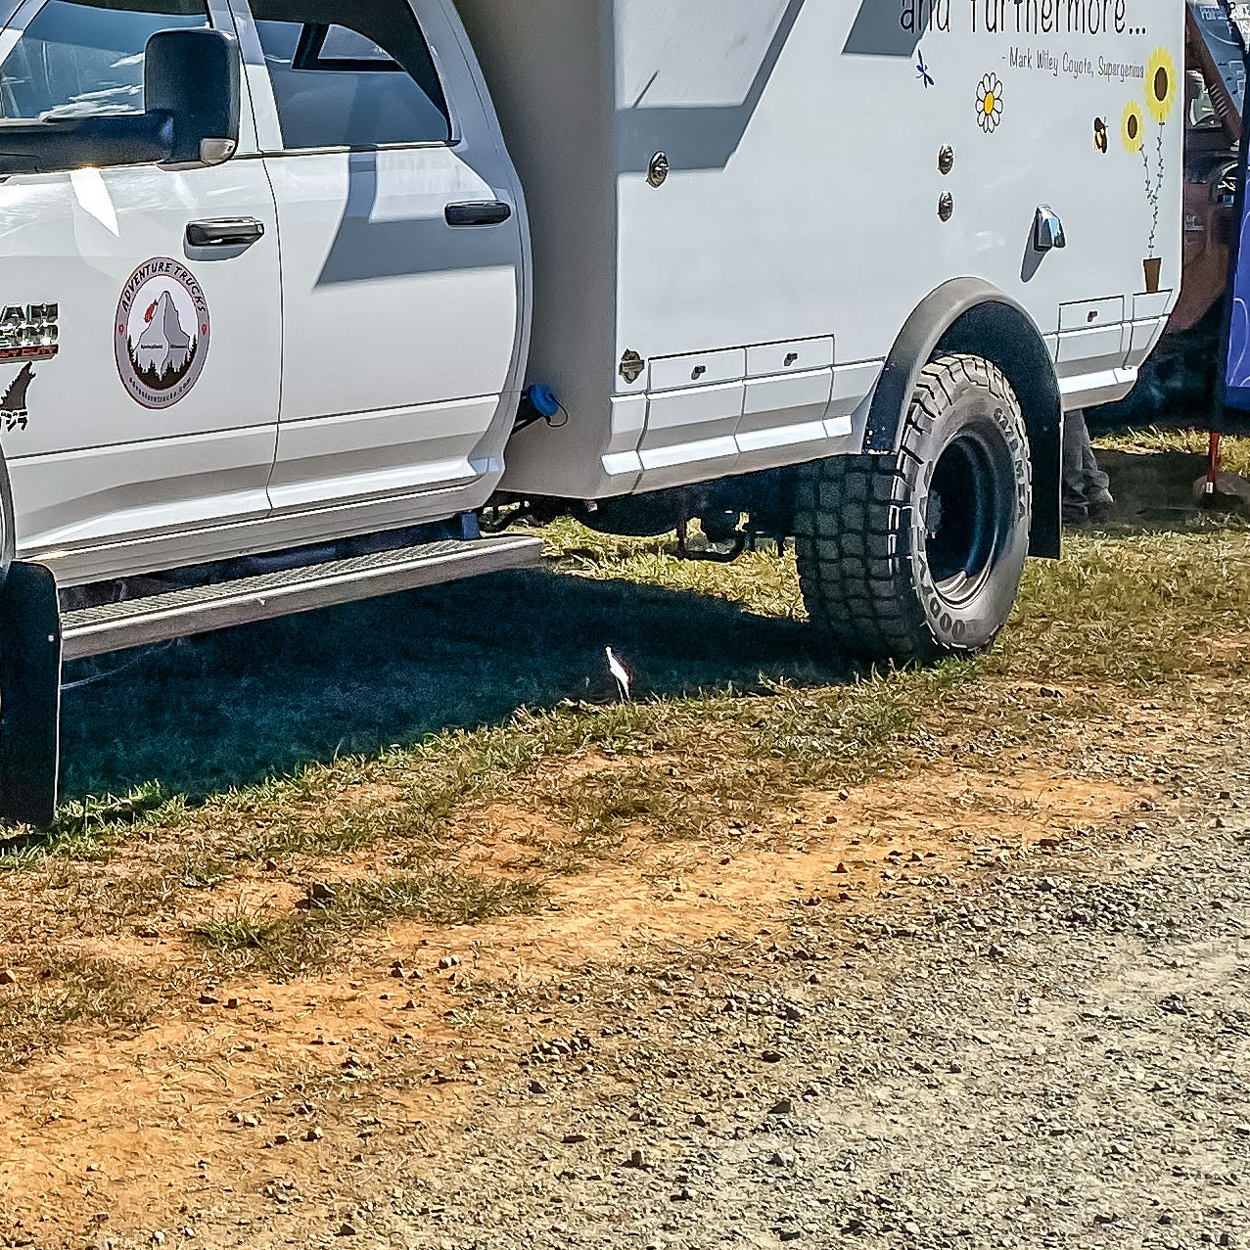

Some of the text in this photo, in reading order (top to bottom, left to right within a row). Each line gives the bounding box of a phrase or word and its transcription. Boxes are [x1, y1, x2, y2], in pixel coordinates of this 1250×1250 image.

[1009, 46, 1033, 69] Mark
[1036, 49, 1058, 77] Wiley
[1062, 51, 1094, 78] Coyote,
[1097, 55, 1144, 83] Supergenius
[122, 261, 206, 312] ADVENTURE TRUCKS
